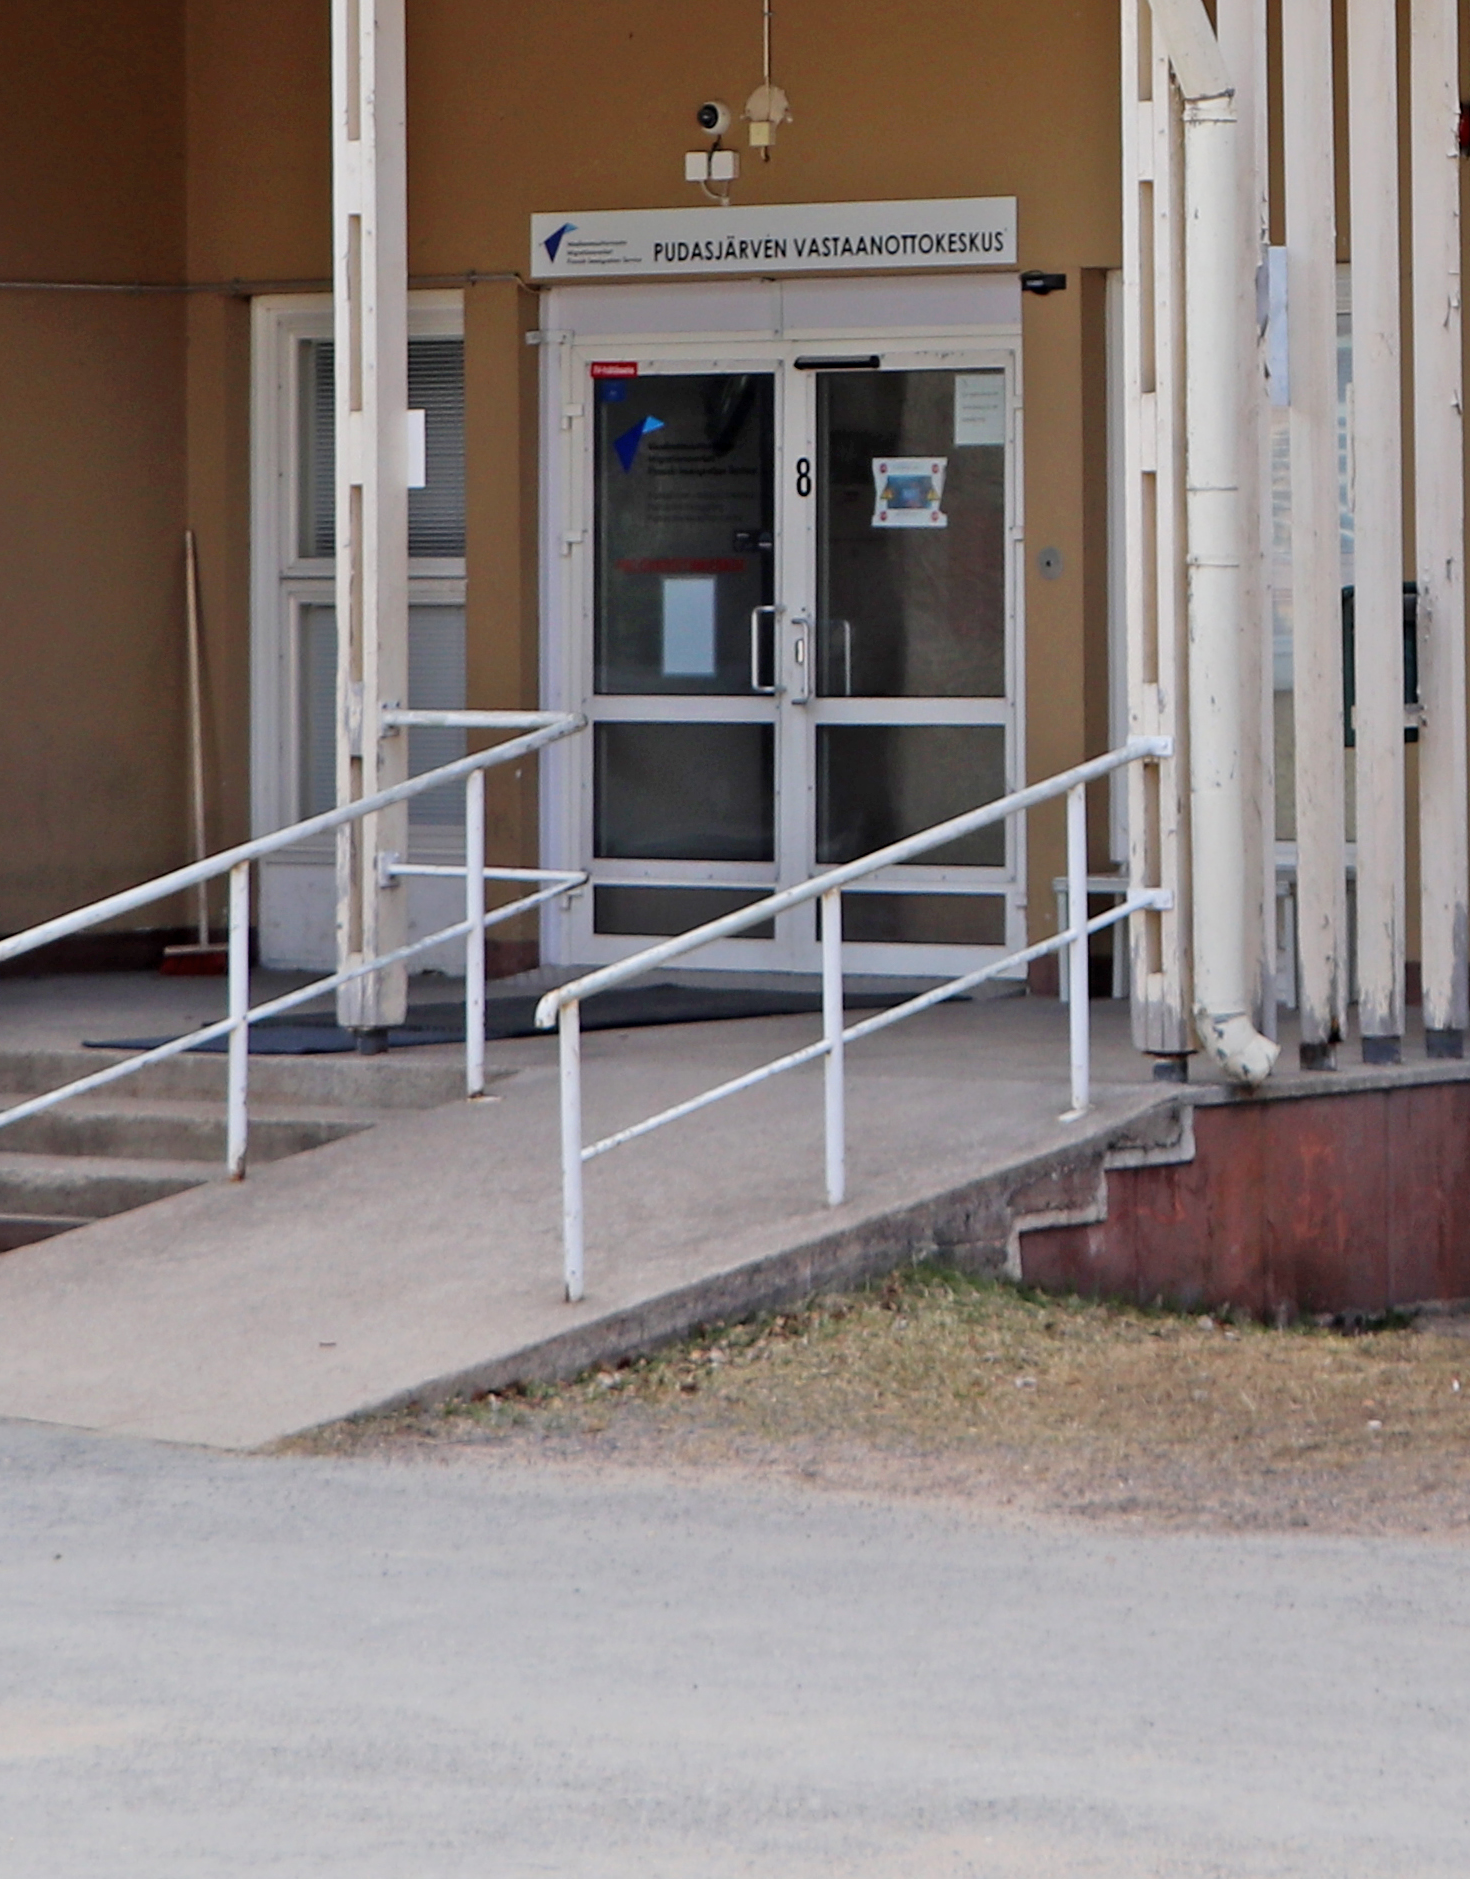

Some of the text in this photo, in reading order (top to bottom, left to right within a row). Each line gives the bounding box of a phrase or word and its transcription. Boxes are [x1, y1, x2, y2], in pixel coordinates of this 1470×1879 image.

[653, 231, 1004, 262] PUDASJÄRVEN VASTAANOTTOKESKUS
[796, 457, 812, 497] 8
